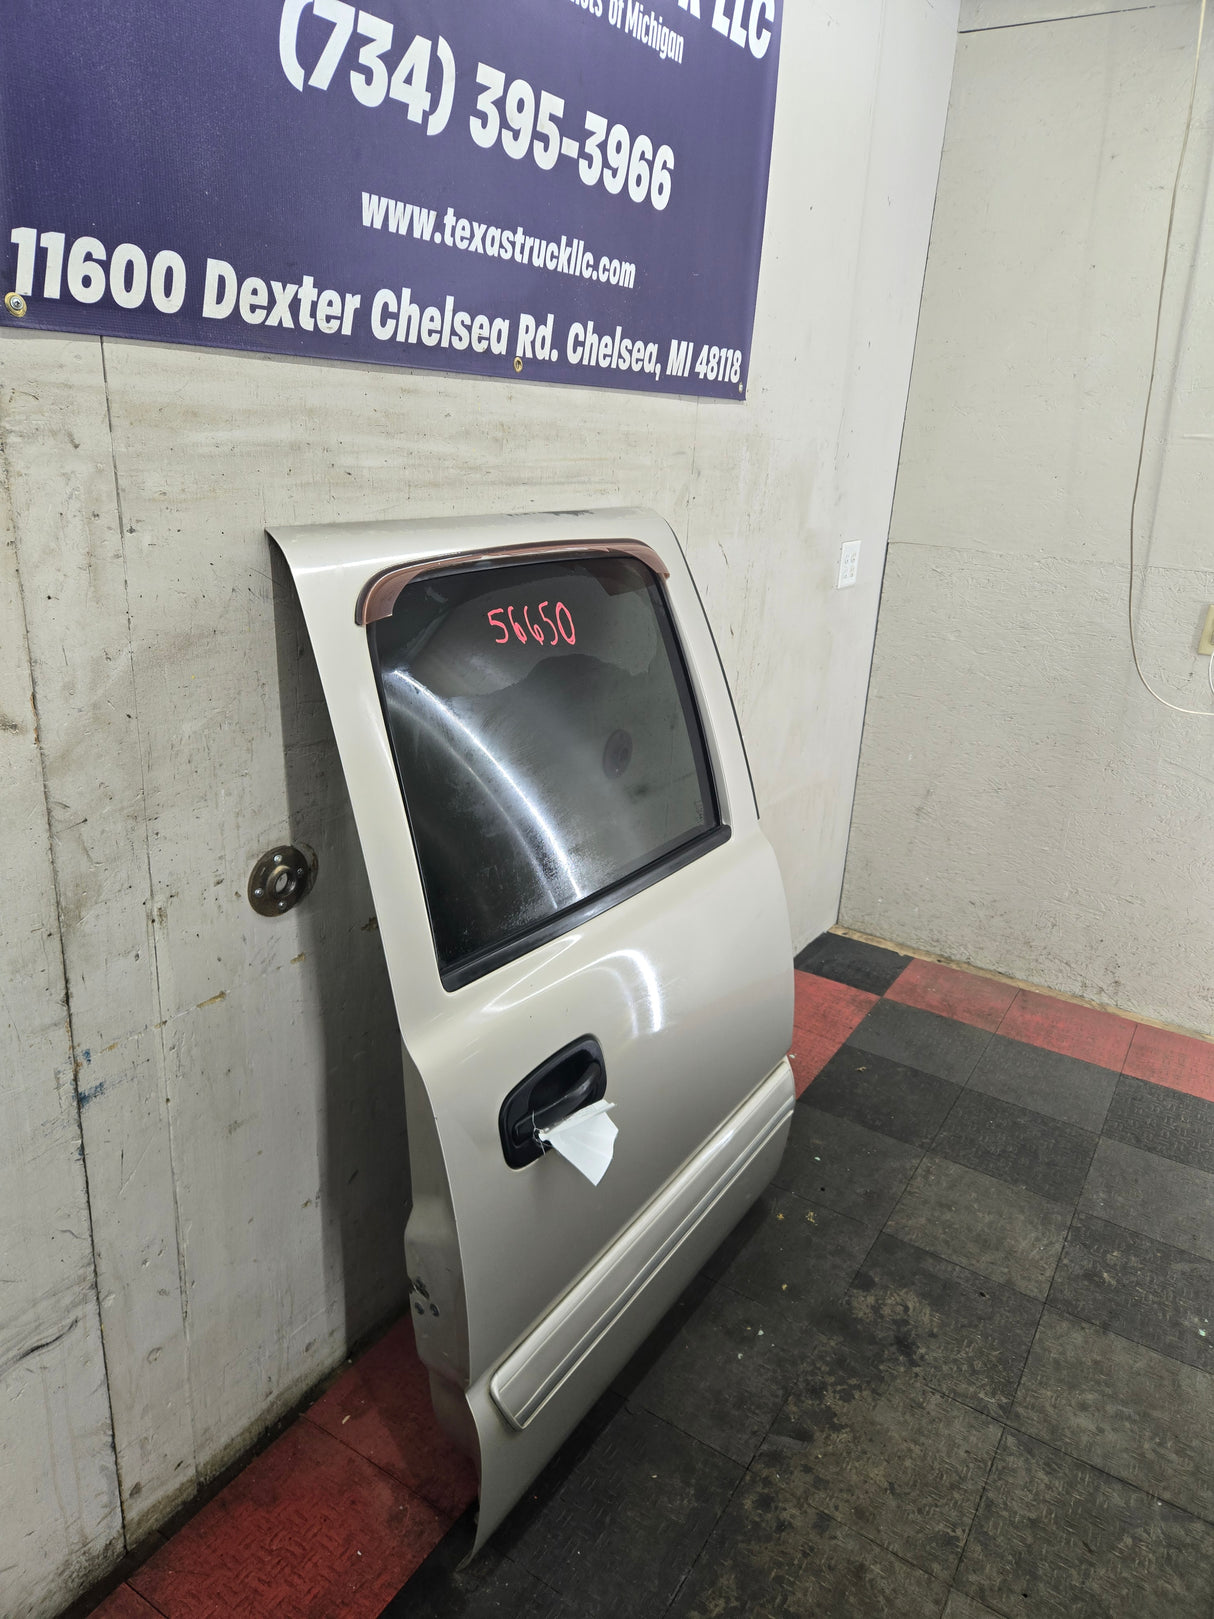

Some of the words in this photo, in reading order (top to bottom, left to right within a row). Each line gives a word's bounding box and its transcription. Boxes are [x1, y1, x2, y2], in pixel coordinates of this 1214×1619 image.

[608, 0, 625, 29] of
[624, 0, 685, 65] Michigan
[711, 0, 775, 59] LLC
[279, 0, 456, 136] (734)
[469, 61, 676, 211] 395-3966
[361, 191, 636, 289] www.texastruckllc.com
[9, 226, 188, 315] 11600
[202, 257, 362, 336] Dexter
[370, 287, 511, 356] Chelsea
[515, 313, 560, 363] Rd.
[566, 320, 662, 382] Chelsea,
[665, 338, 695, 378] MI
[694, 344, 743, 384] 48118
[487, 601, 576, 646] 56650
